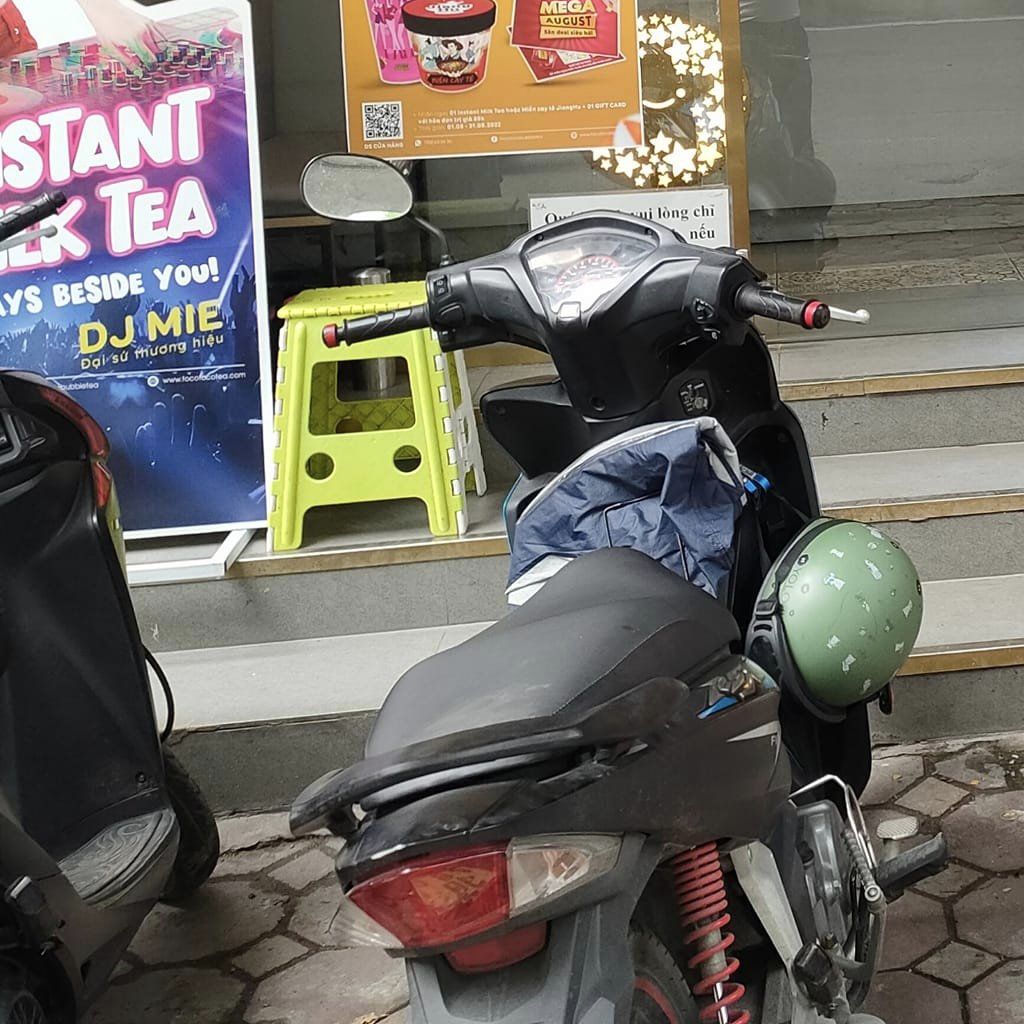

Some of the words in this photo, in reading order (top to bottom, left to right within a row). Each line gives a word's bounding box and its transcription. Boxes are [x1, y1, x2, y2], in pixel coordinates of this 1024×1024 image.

[540, 0, 595, 15] MEGA
[545, 16, 592, 27] AUGUST
[0, 87, 211, 188] STANT
[99, 178, 215, 254] TEA
[658, 206, 689, 221] lòng
[689, 223, 715, 240] nếu
[52, 272, 146, 308] BESIDE
[153, 256, 220, 291] YOU!
[78, 312, 135, 355] DJ
[146, 299, 225, 343] MIE
[192, 332, 225, 351] hiệu
